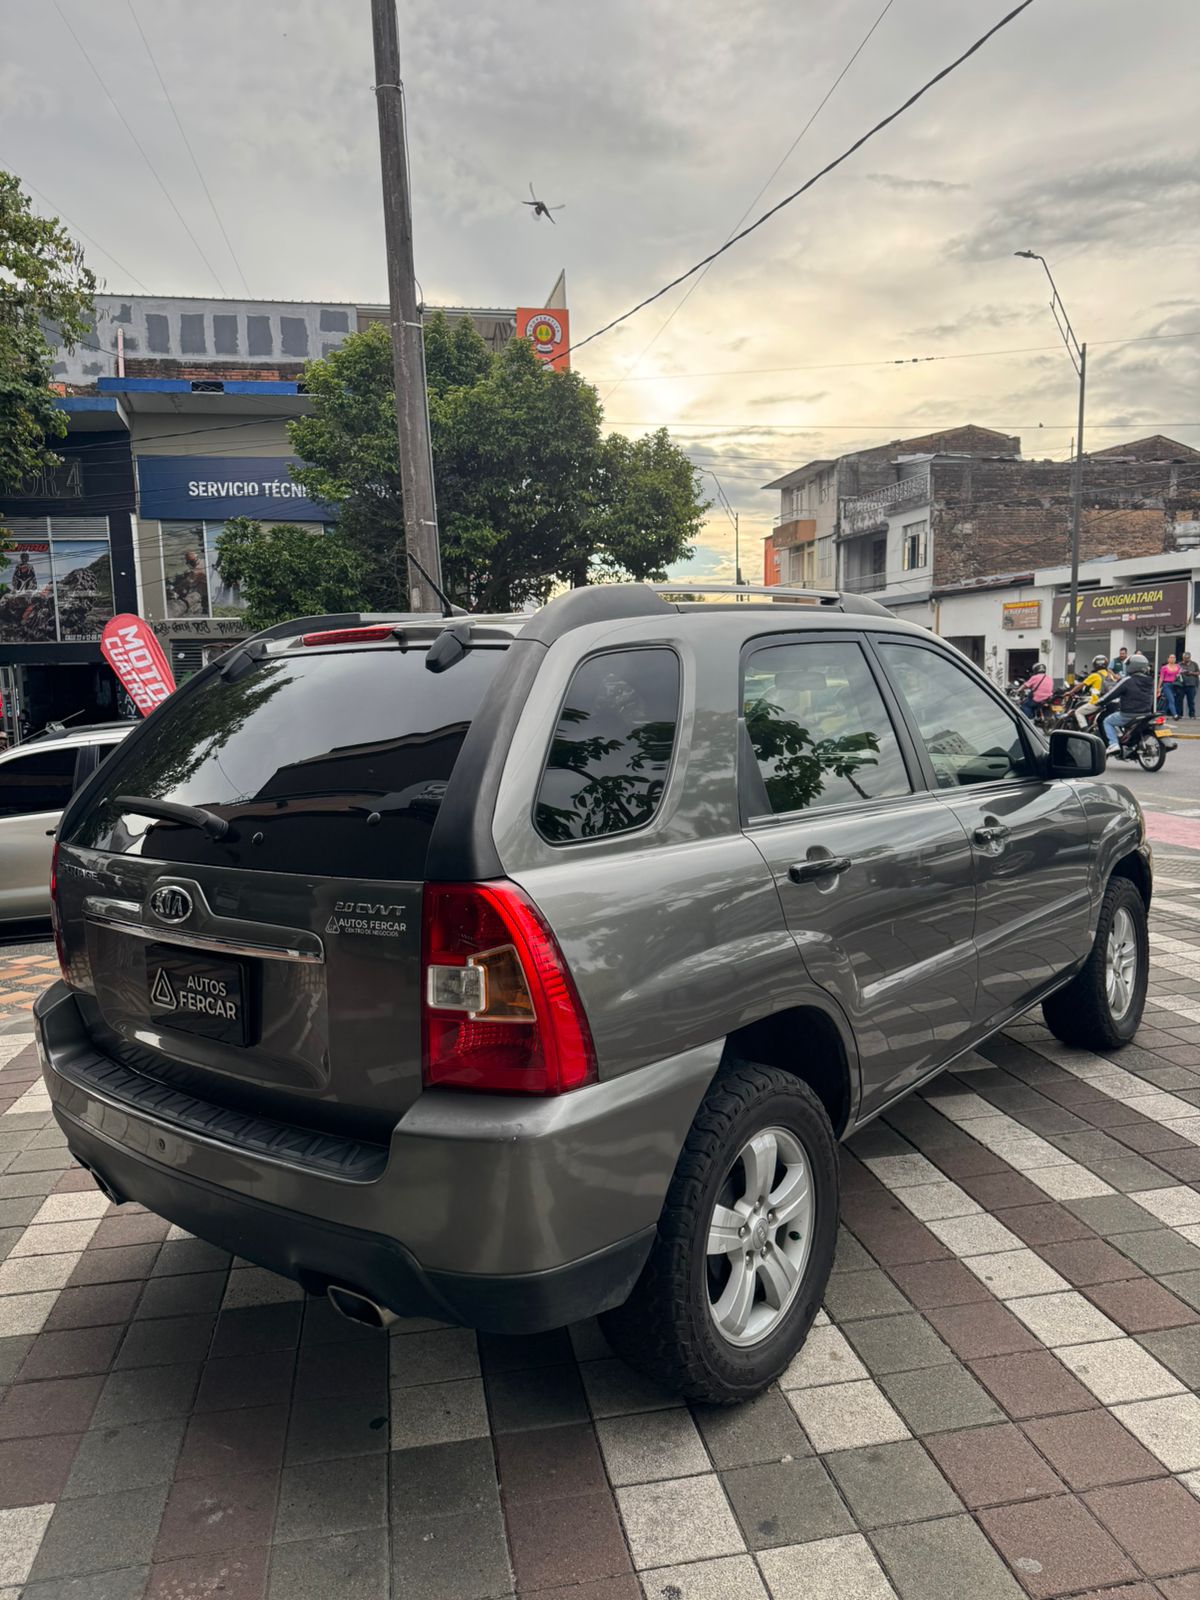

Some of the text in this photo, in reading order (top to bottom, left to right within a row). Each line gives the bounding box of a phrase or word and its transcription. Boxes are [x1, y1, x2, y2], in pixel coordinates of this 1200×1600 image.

[66, 461, 82, 497] 4
[188, 479, 312, 498] SERVICIO TÉCNI
[1092, 590, 1164, 608] CONSIGNATARIA
[105, 637, 153, 708] CUATRO
[118, 625, 171, 707] MOTO
[155, 889, 183, 917] KIA
[356, 903, 406, 916] CVVT
[339, 918, 368, 929] AUTOS
[370, 920, 407, 931] FERCAR
[187, 975, 227, 997] AUTOS
[180, 990, 237, 1020] FERCAR
